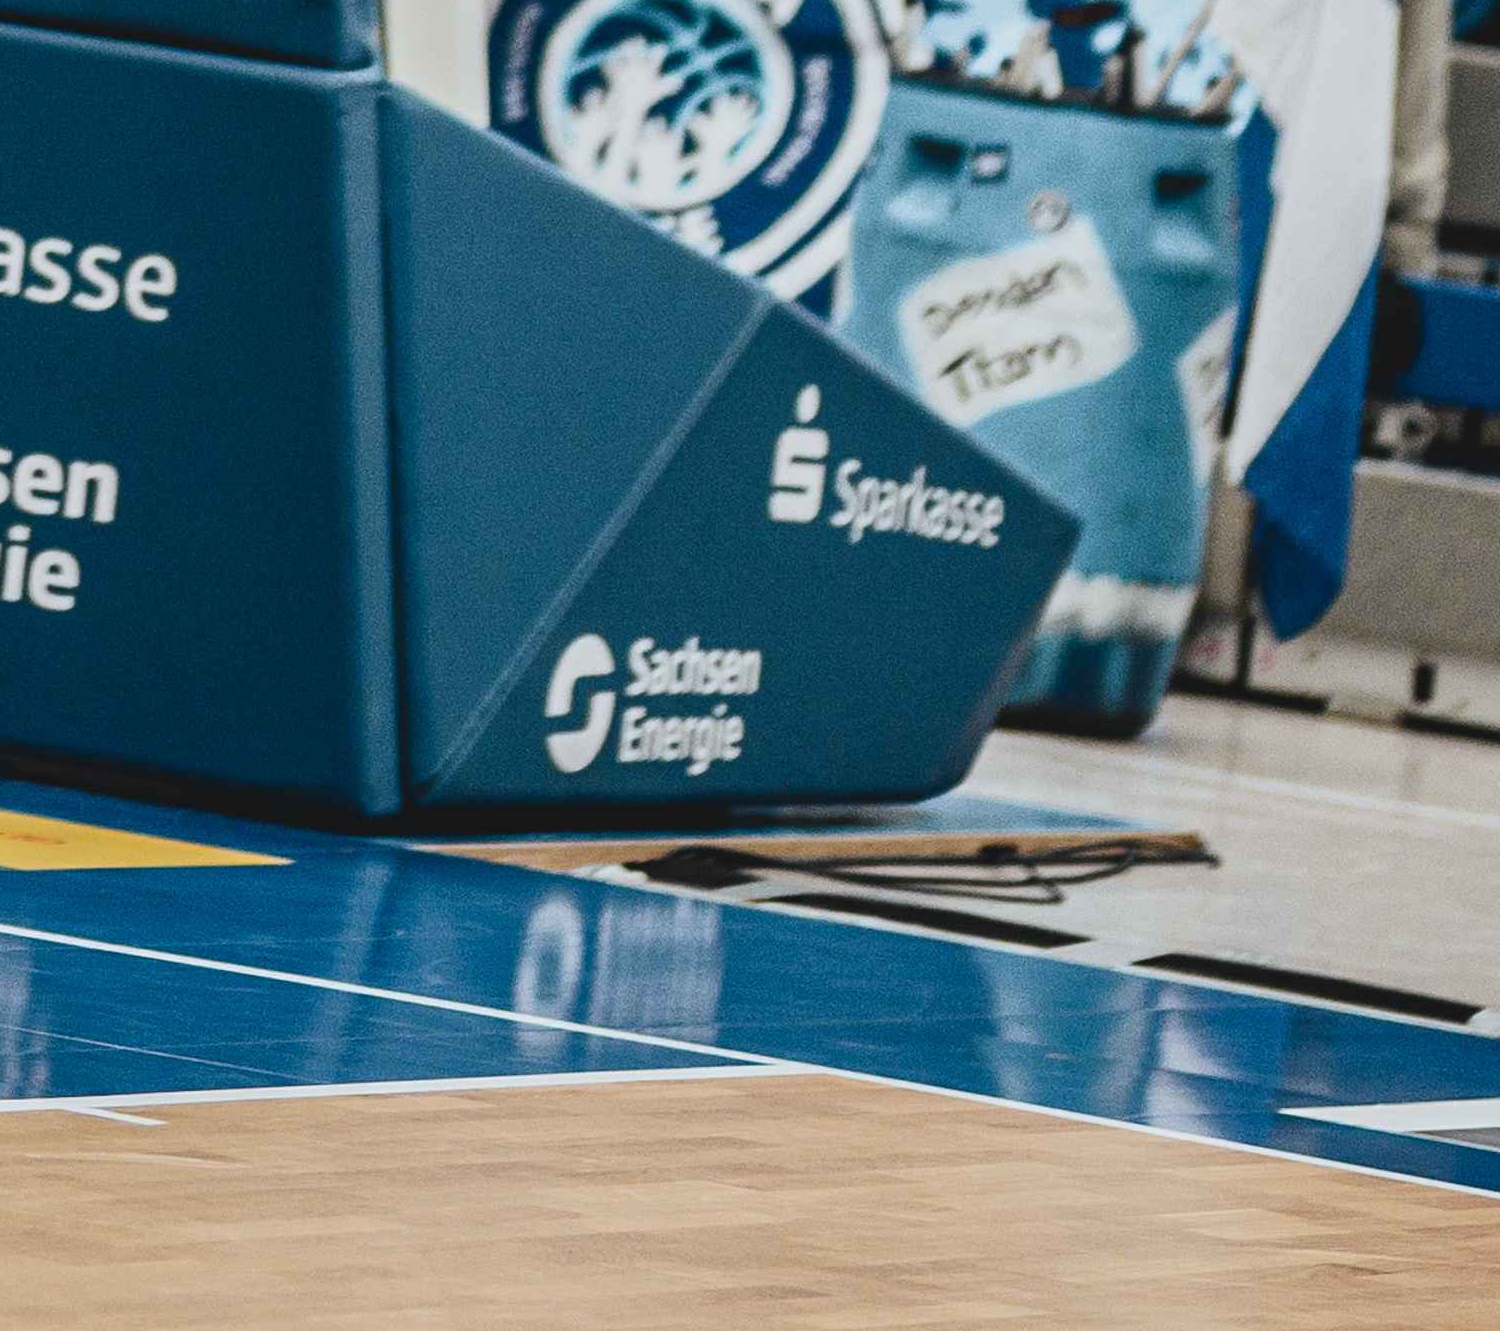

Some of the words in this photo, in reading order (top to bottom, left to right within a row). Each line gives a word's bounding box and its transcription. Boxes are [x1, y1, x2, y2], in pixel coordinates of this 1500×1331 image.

[830, 457, 1005, 548] Sparkasse
[625, 636, 763, 696] Sachsen
[618, 704, 745, 776] Energie
